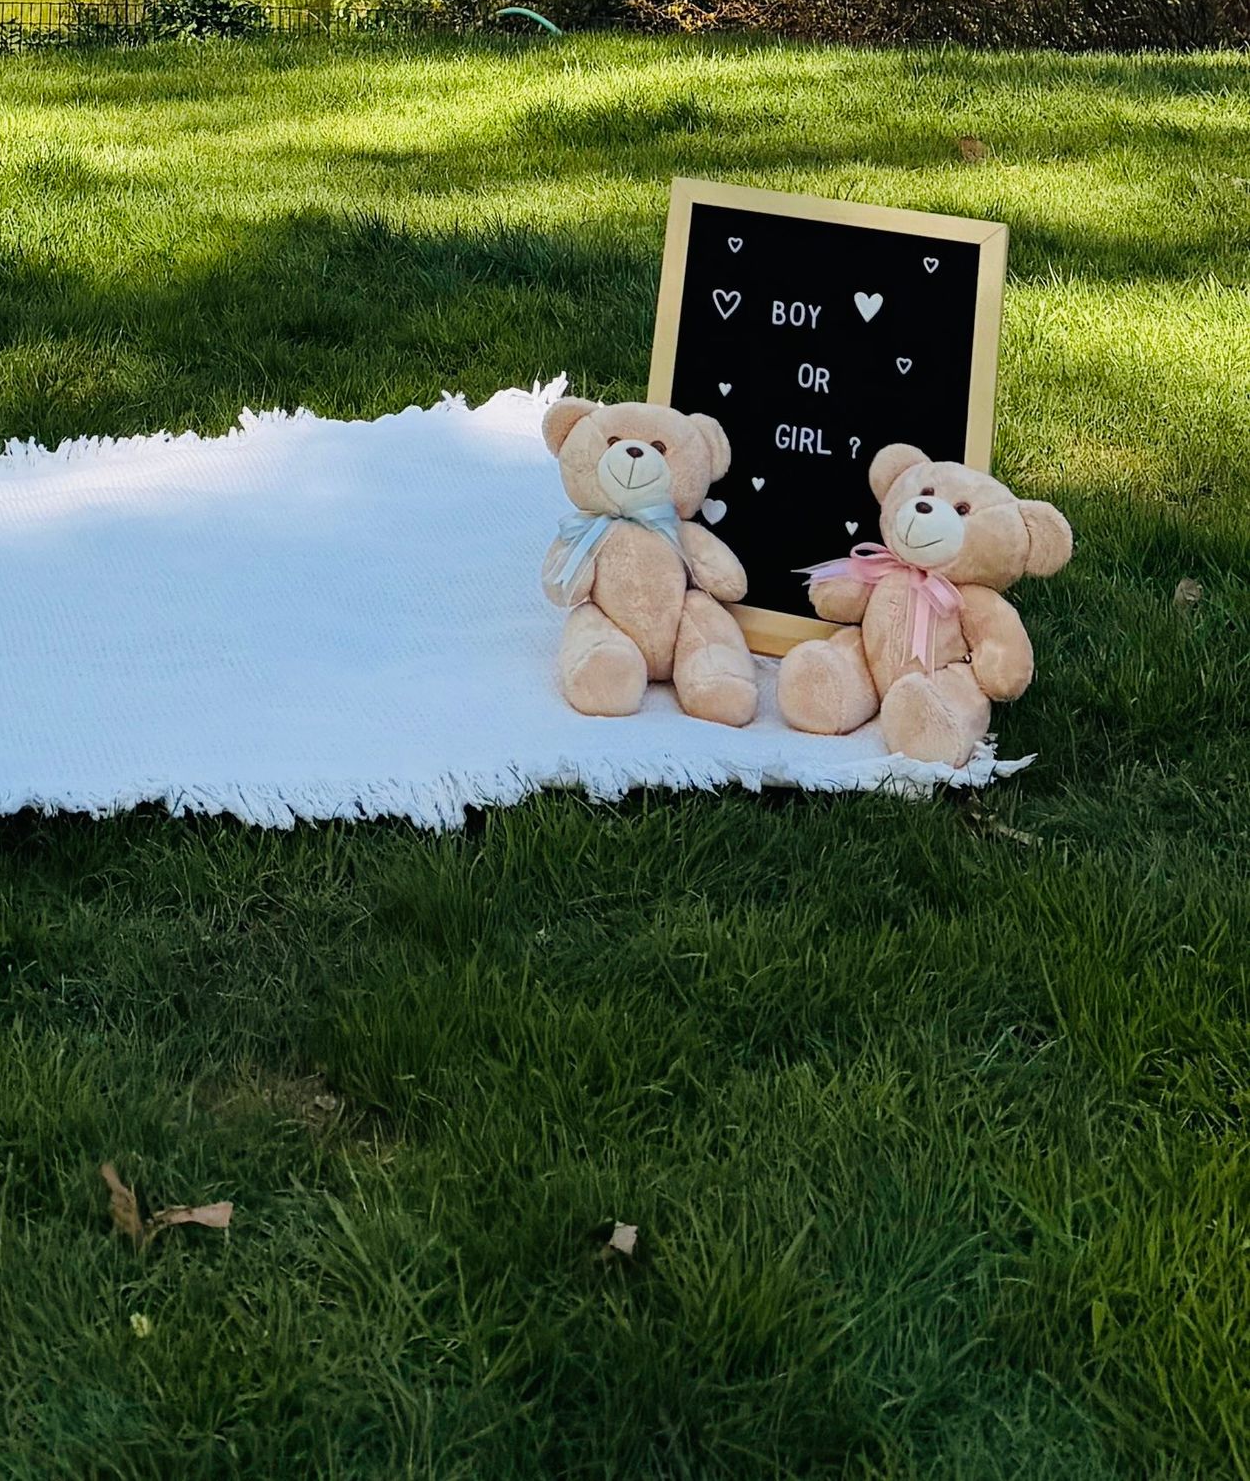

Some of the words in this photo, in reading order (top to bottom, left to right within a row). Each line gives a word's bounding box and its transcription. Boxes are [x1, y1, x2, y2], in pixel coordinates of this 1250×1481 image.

[772, 300, 822, 329] BOY
[797, 363, 830, 394] OR
[775, 424, 832, 455] GIRL
[849, 436, 861, 459] ?
